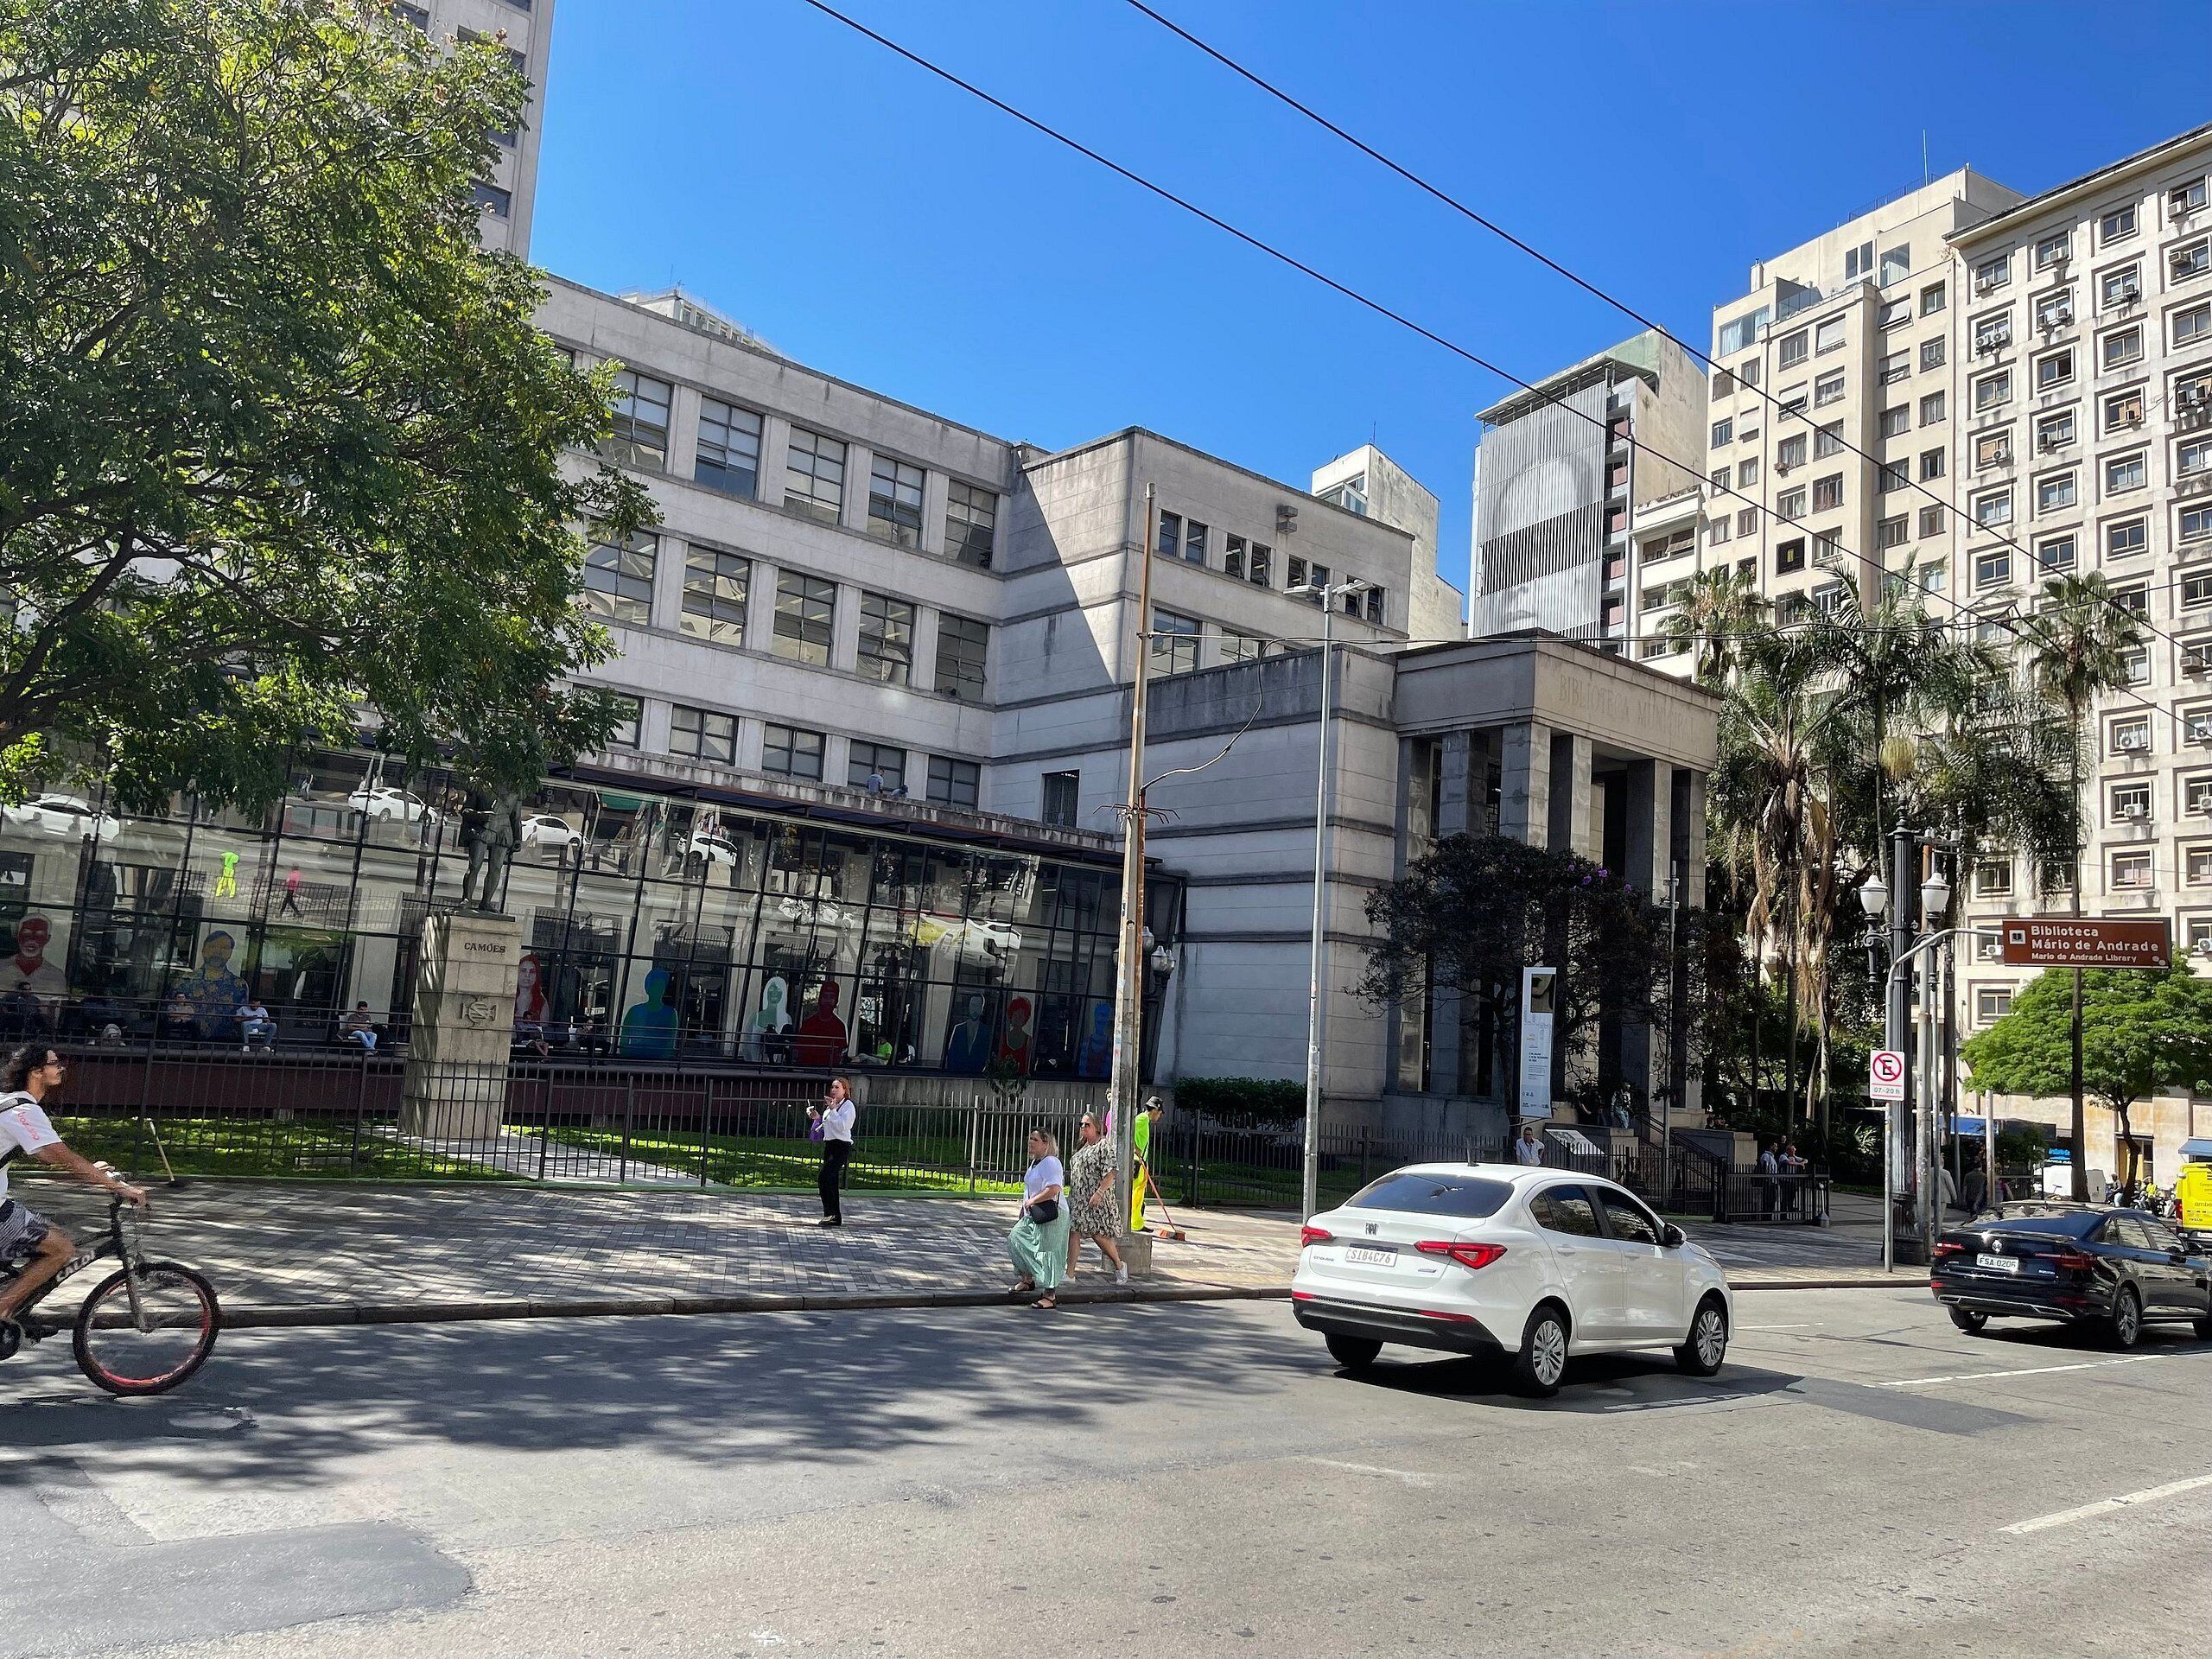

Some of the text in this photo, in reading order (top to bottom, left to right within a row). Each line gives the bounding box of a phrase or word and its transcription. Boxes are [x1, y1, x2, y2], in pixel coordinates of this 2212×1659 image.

[1559, 674, 1630, 723] BIBLIOTECA
[2031, 925, 2099, 938] Biblioteca
[2031, 938, 2158, 952] Mário de Andrade
[2069, 953, 2103, 962] Andrade
[2106, 954, 2137, 963] Library
